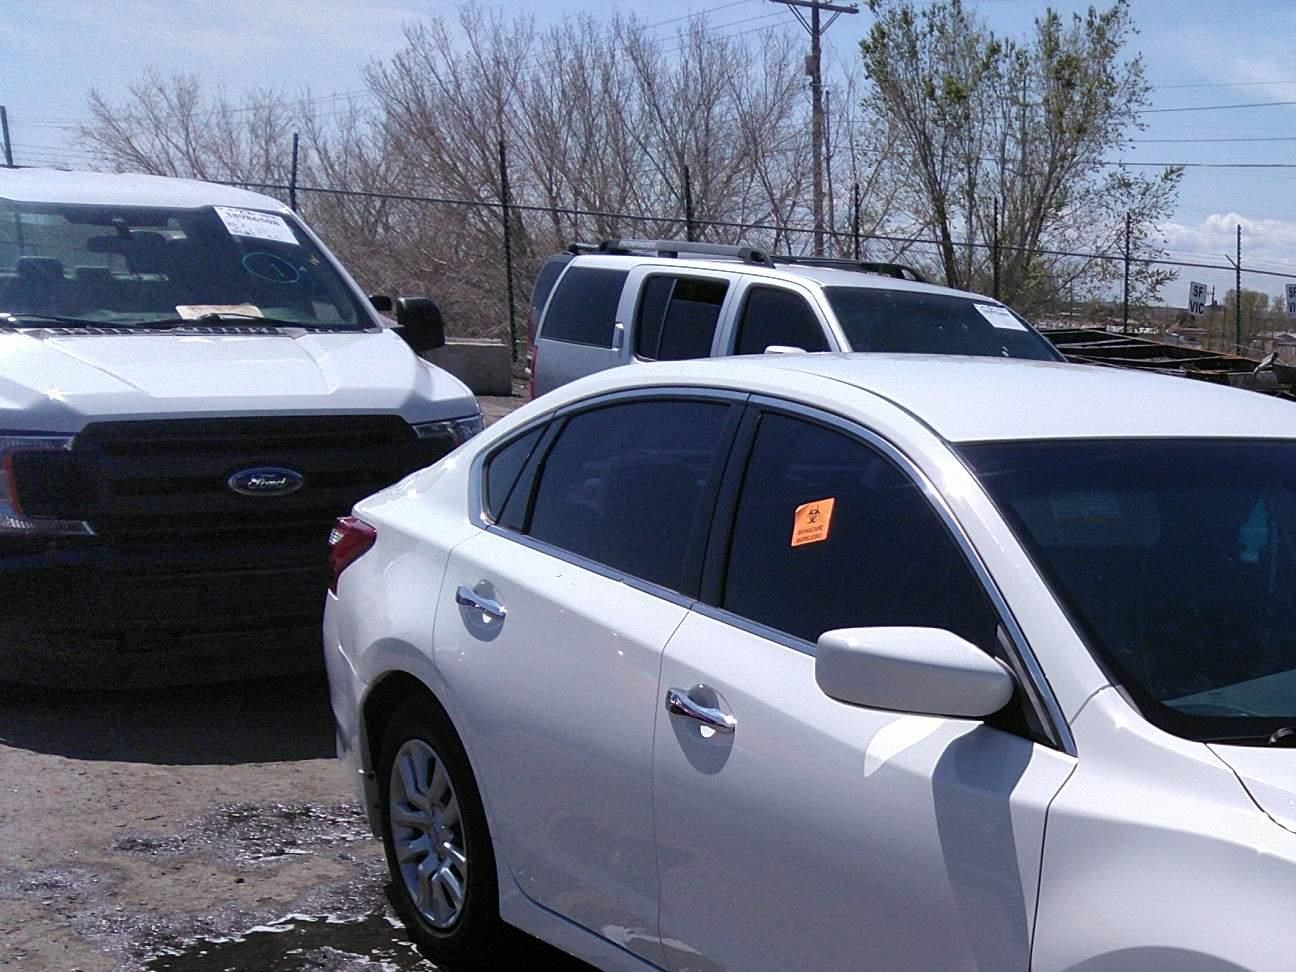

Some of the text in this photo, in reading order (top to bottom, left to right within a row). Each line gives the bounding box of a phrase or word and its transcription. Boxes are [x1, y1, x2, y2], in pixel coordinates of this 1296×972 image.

[1193, 285, 1203, 298] SF
[1288, 286, 1296, 298] SF
[1190, 301, 1204, 315] VIC
[247, 476, 288, 489] Ford
